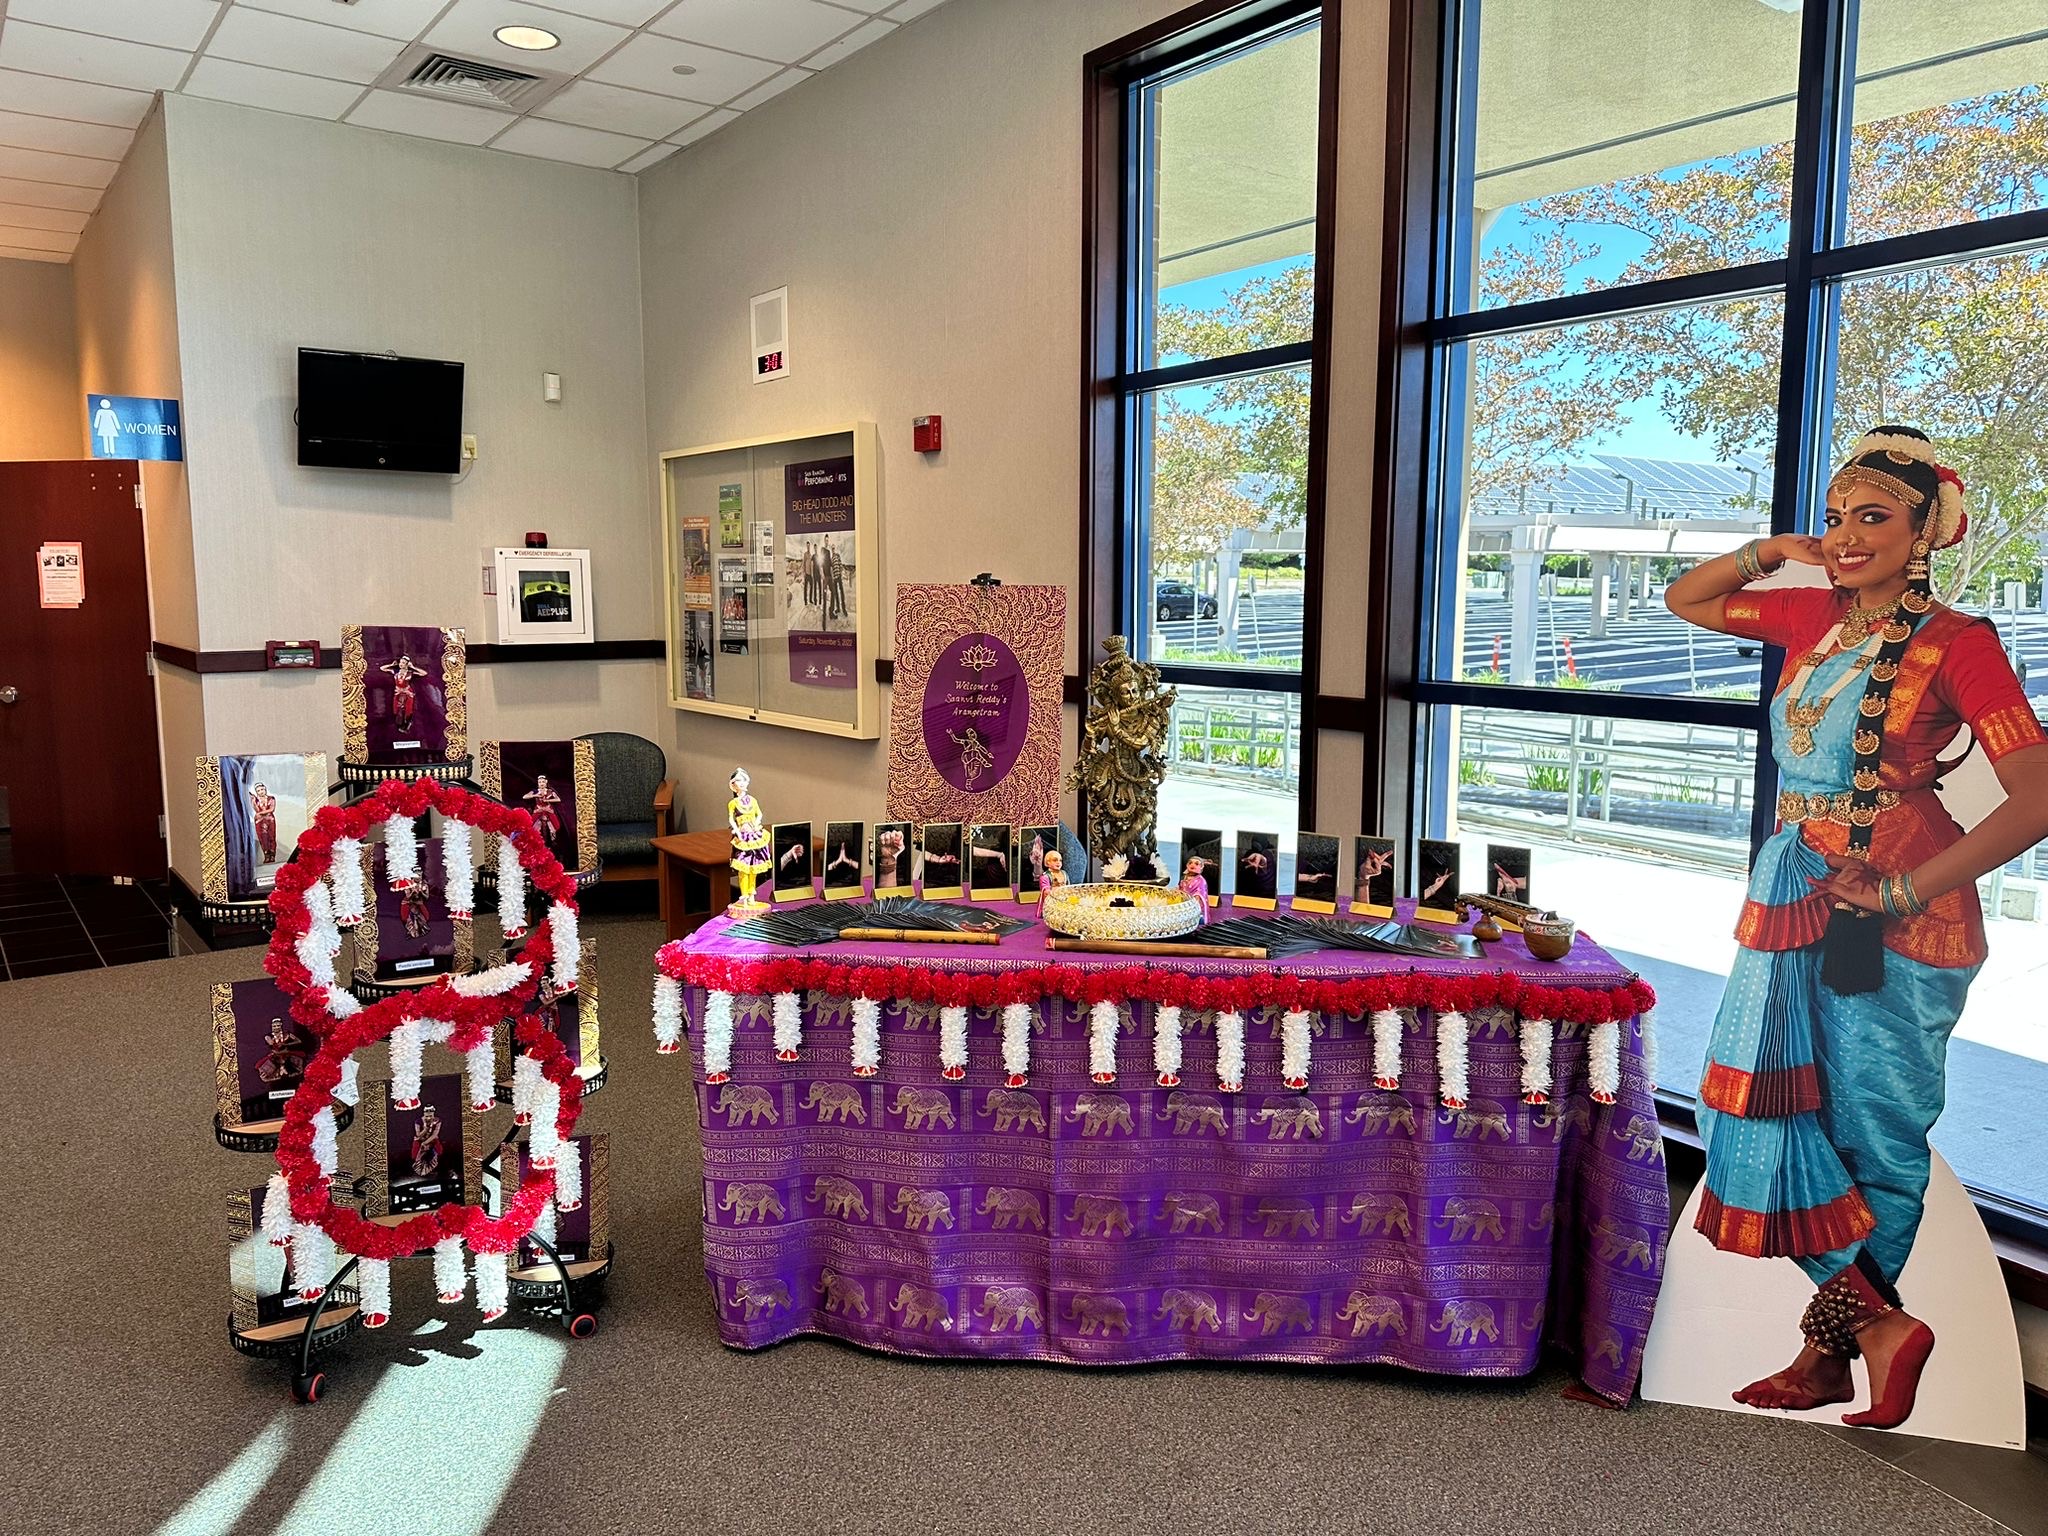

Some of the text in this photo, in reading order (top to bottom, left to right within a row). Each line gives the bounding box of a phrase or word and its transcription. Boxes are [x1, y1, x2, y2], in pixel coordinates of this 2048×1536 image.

[123, 422, 177, 436] WOMEN
[804, 475, 834, 486] PERFORMING
[792, 495, 854, 511] BIG HEAD TODD AND
[800, 510, 848, 524] THE MONSTERS
[955, 680, 999, 691] Welcome to
[975, 694, 1008, 706] Reddy's
[952, 707, 1001, 718] Arangetram
